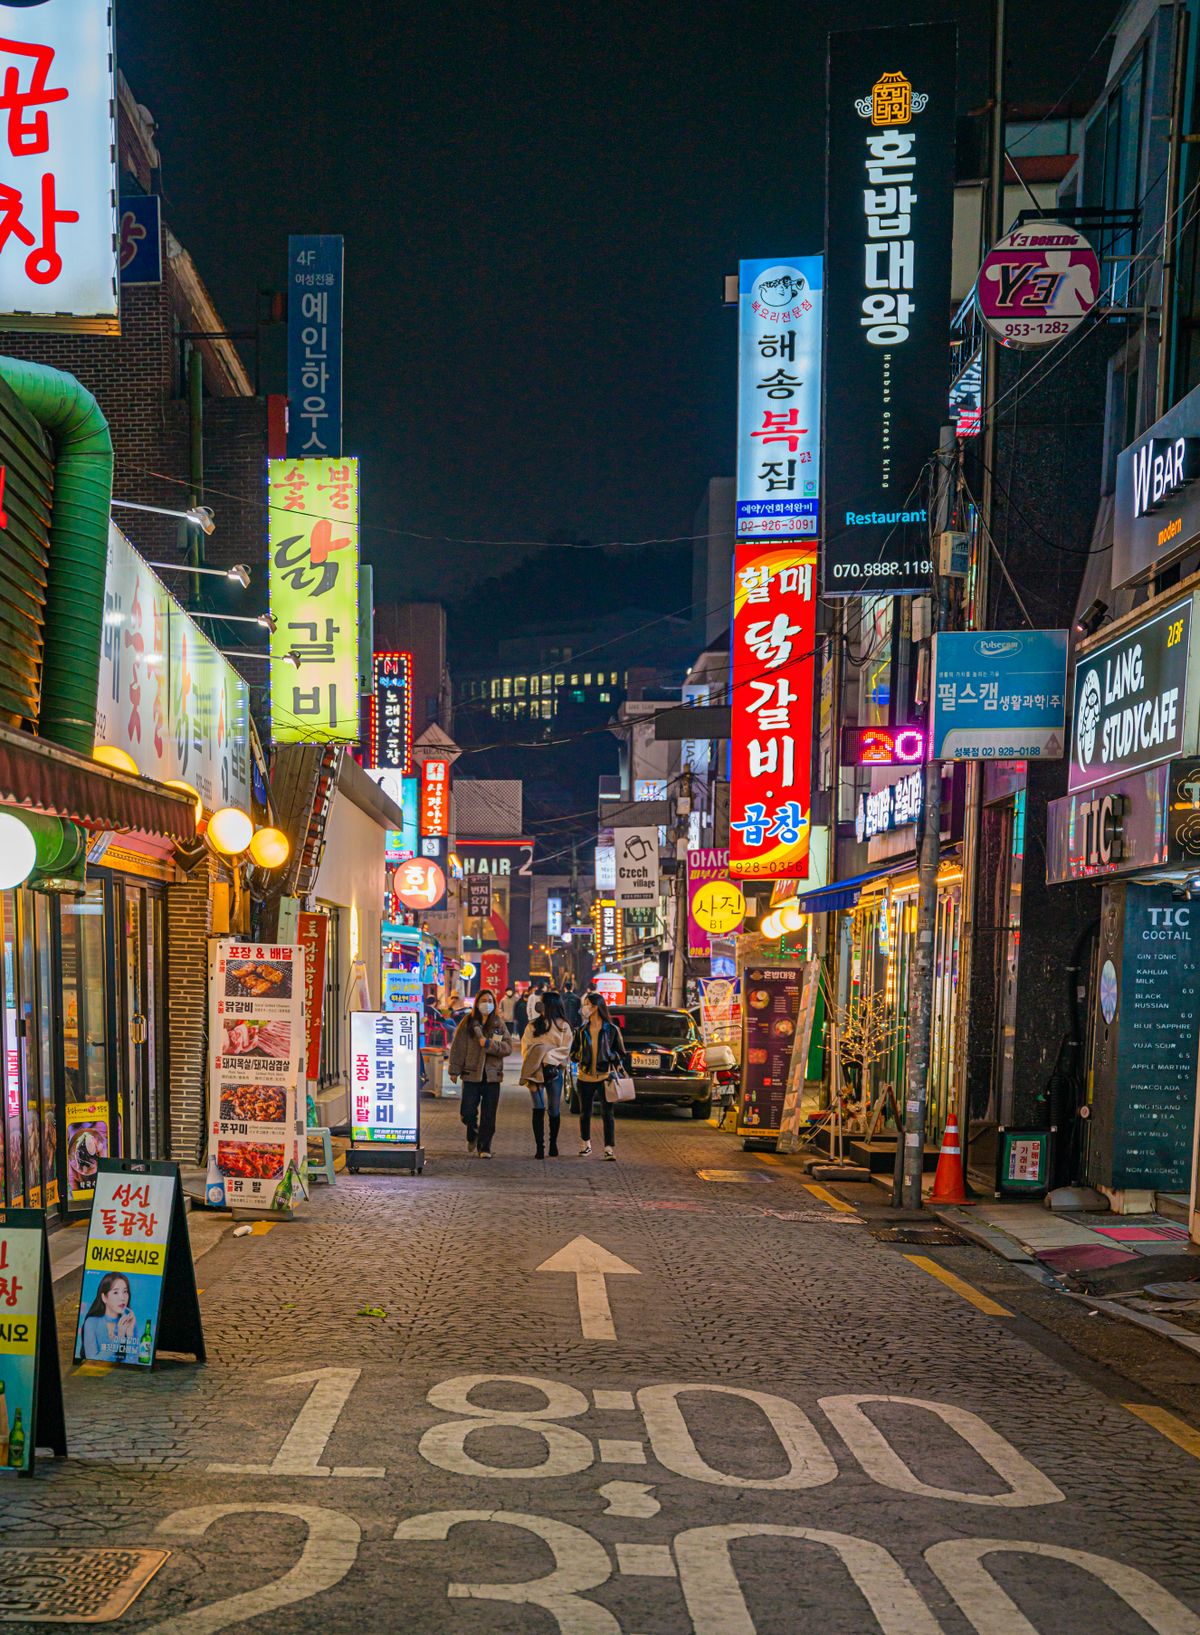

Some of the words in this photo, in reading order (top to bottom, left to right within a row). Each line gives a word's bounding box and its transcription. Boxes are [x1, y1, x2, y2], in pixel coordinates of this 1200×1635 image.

[860, 130, 918, 345] 혼밥대왕
[296, 251, 317, 266] 4F
[295, 273, 335, 286] 여성전용
[1005, 321, 1070, 337] 953-1282
[882, 353, 892, 403] Honbab
[882, 411, 892, 450] Great
[741, 520, 815, 532] 02-926-3091
[846, 509, 928, 525] Restaurant
[1157, 517, 1183, 546] modern
[738, 564, 813, 605] 할매
[1105, 643, 1146, 704] LANG.
[744, 612, 803, 788] 닭갈비
[938, 682, 999, 711] 펄스캠
[954, 747, 980, 758] 성북점
[982, 747, 996, 758] 02)
[998, 746, 1041, 757] 928-0188
[731, 801, 807, 846] 곱창
[463, 857, 511, 876] HAIR
[518, 845, 534, 877] 2
[735, 861, 804, 873] 928-0356
[619, 866, 648, 879] Czech
[400, 866, 437, 903] 회
[633, 879, 656, 888] village
[695, 894, 742, 915] 사진
[709, 920, 723, 929] B1
[1147, 908, 1190, 926] TIC
[1142, 930, 1192, 941] COCTAIL
[228, 946, 251, 959] 포장
[256, 947, 265, 959] &
[269, 948, 293, 961] 배달
[1153, 953, 1177, 961] TONIC
[763, 970, 797, 981] 혼밥대왕
[1136, 968, 1169, 976] KAHLUA
[1135, 992, 1162, 1000] BLACK
[225, 1001, 253, 1014] 닭갈비
[399, 1015, 415, 1051] 할매
[112, 1183, 151, 1208] 성신
[100, 1208, 158, 1237] 돌곱창
[91, 1245, 160, 1266] 어서오십시오
[207, 1367, 1067, 1508] 18:00
